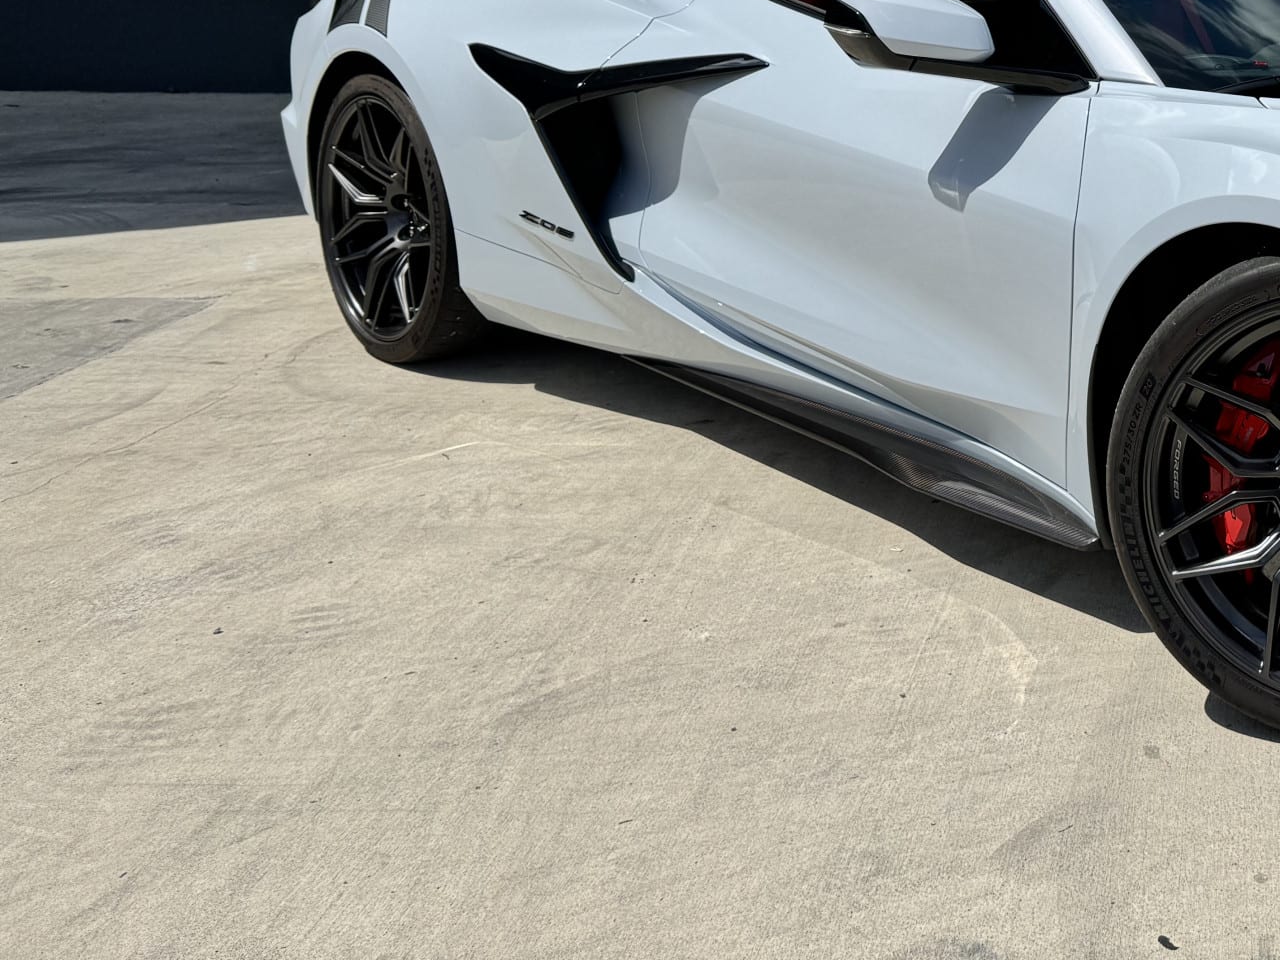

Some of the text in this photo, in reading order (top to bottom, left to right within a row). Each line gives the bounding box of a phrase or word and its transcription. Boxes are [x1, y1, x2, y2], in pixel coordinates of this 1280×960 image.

[519, 210, 575, 239] Z06
[1122, 420, 1137, 465] 275/30
[1173, 439, 1182, 500] FORGED
[1123, 522, 1169, 620] MICHELIN
